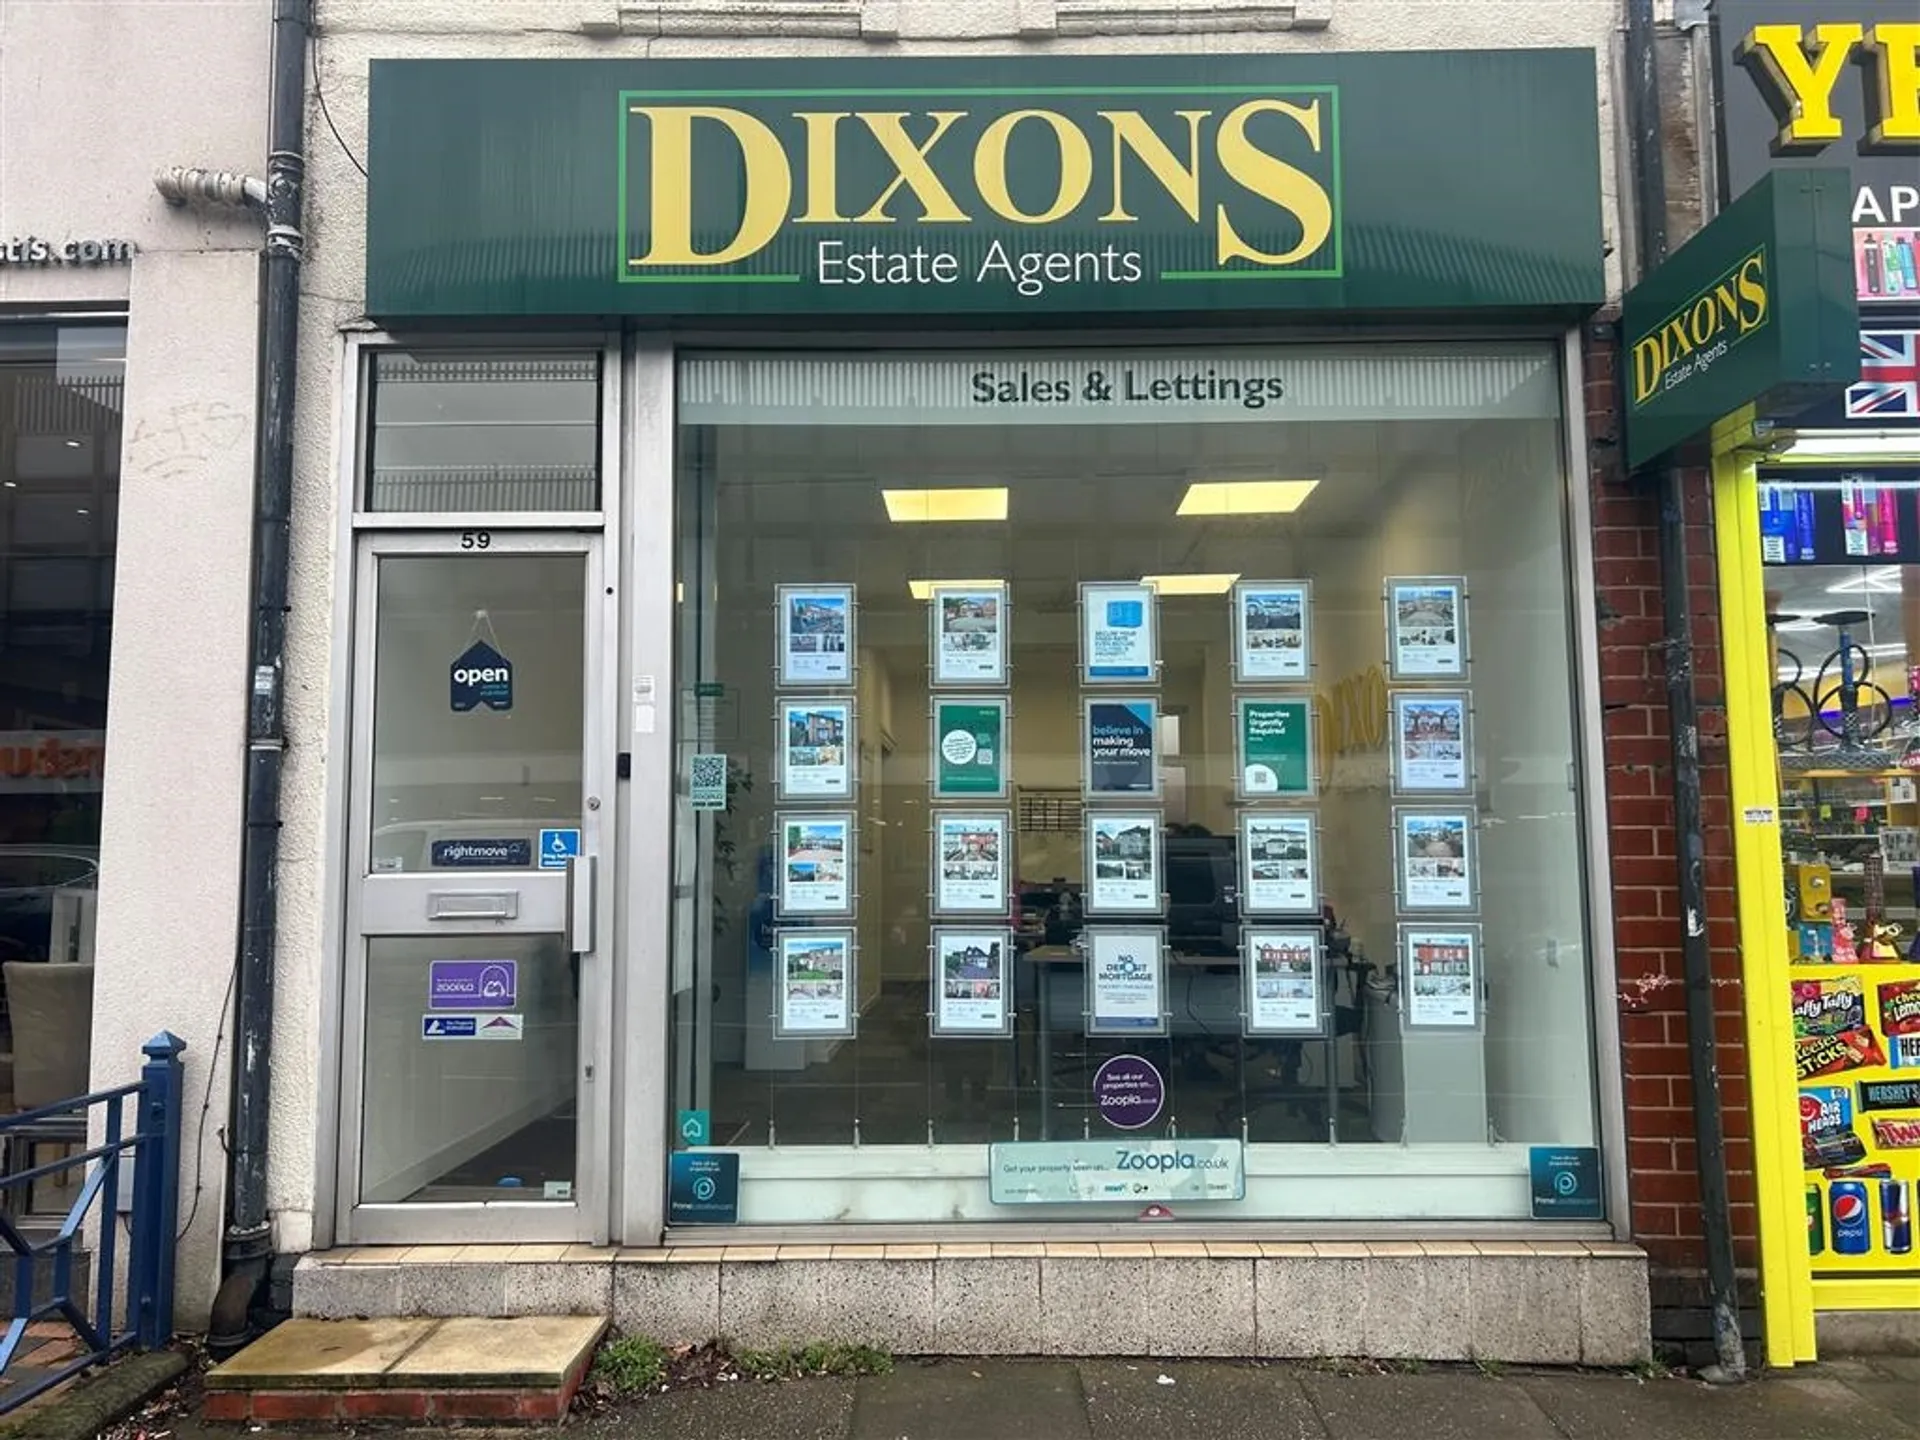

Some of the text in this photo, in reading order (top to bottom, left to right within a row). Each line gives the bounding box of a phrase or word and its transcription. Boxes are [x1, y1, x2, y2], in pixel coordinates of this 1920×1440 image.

[628, 98, 1333, 266] DIXONS
[0, 239, 136, 262] tis.com
[817, 240, 1142, 296] Estate Agents
[1634, 254, 1767, 404] DIXONS
[1665, 340, 1728, 390] Estate Agents
[972, 369, 1284, 409] Sales & Lettings
[461, 532, 491, 549] 59
[453, 667, 509, 687] open
[1093, 725, 1144, 735] believe in
[1093, 736, 1134, 748] making
[1093, 747, 1151, 758] your move
[444, 844, 508, 859] rightmove
[1099, 973, 1152, 981] MORTGAGE
[1792, 1000, 1821, 1017] affy
[1837, 1229, 1863, 1238] pepsi
